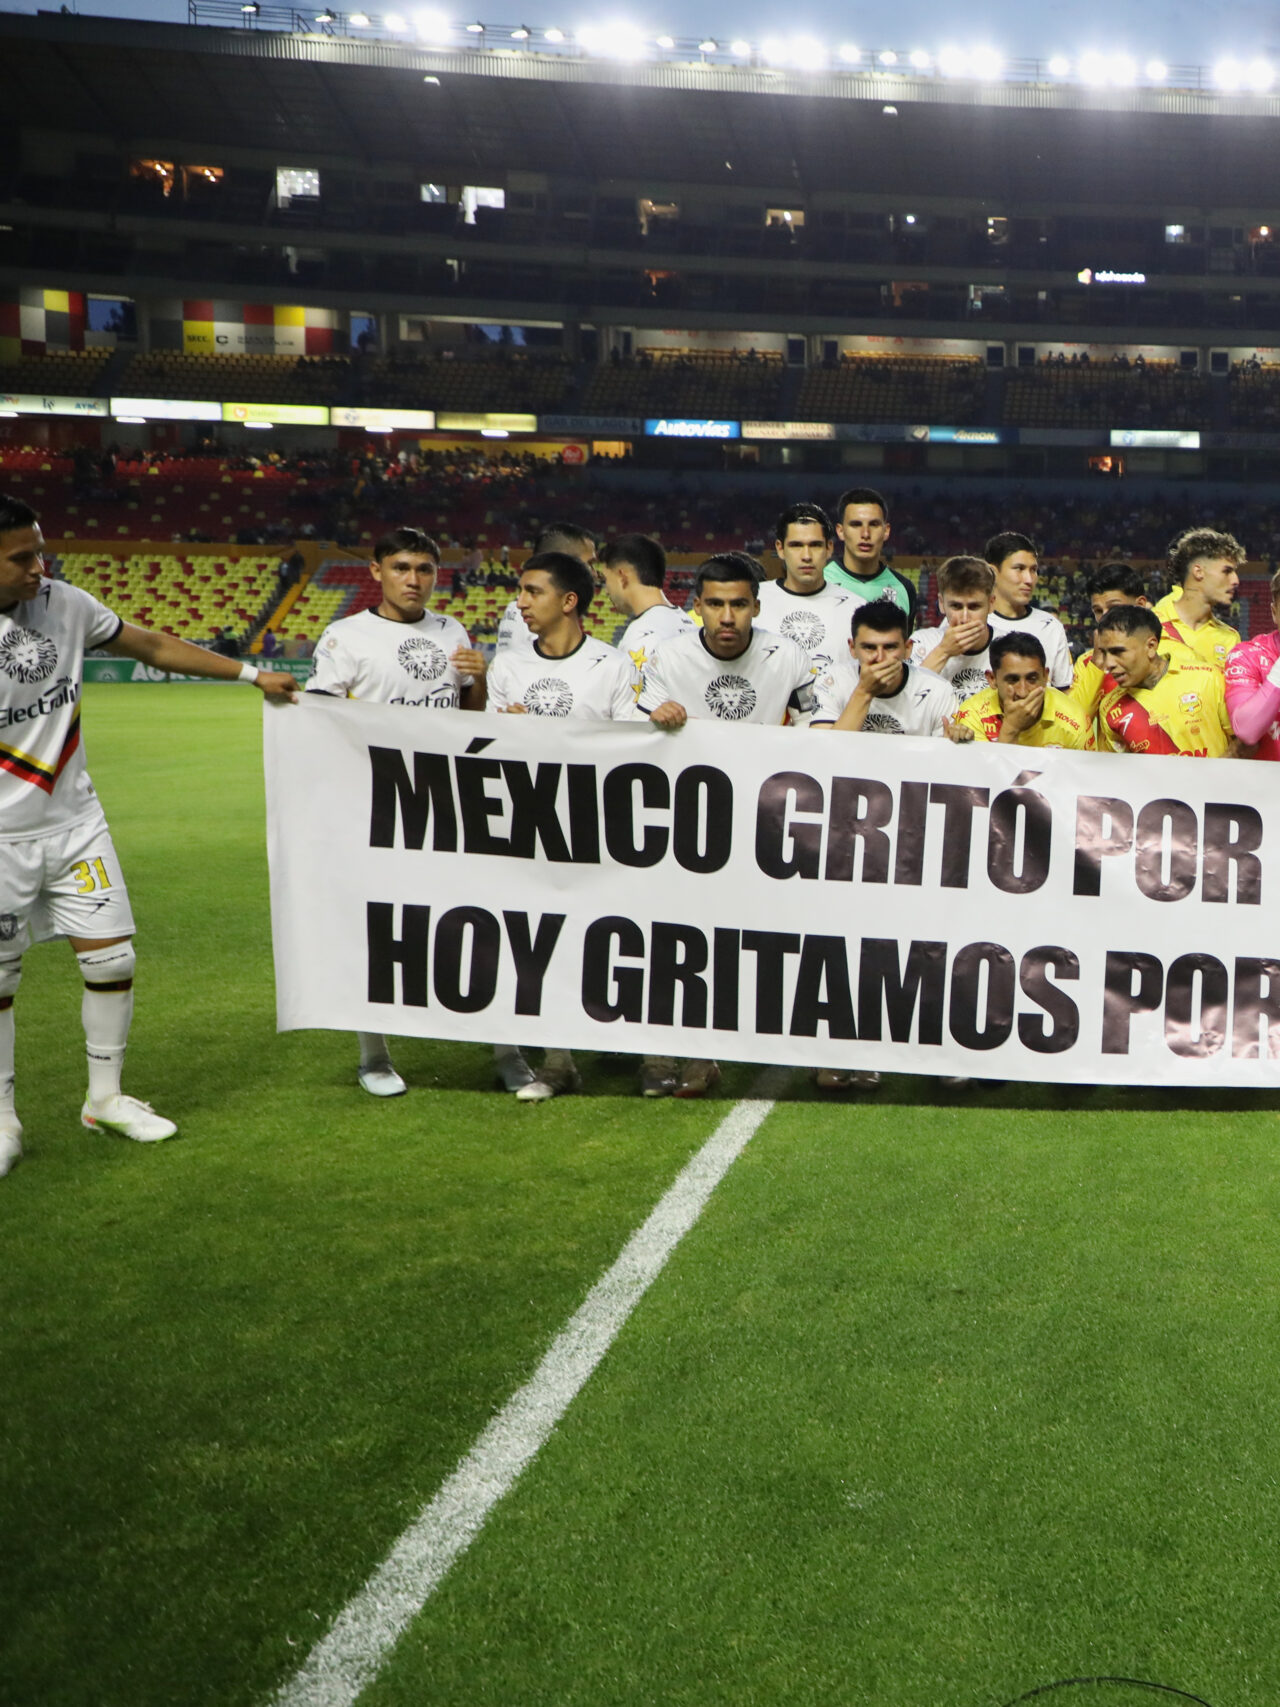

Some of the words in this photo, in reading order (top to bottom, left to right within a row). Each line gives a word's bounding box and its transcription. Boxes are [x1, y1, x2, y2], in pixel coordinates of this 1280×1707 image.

[70, 856, 112, 895] 31
[368, 738, 734, 875] MÉXICO
[755, 770, 1053, 895] GRITÓ
[1073, 795, 1263, 905] POR
[366, 901, 567, 1017] HOY
[582, 915, 1080, 1055] GRITAMOS
